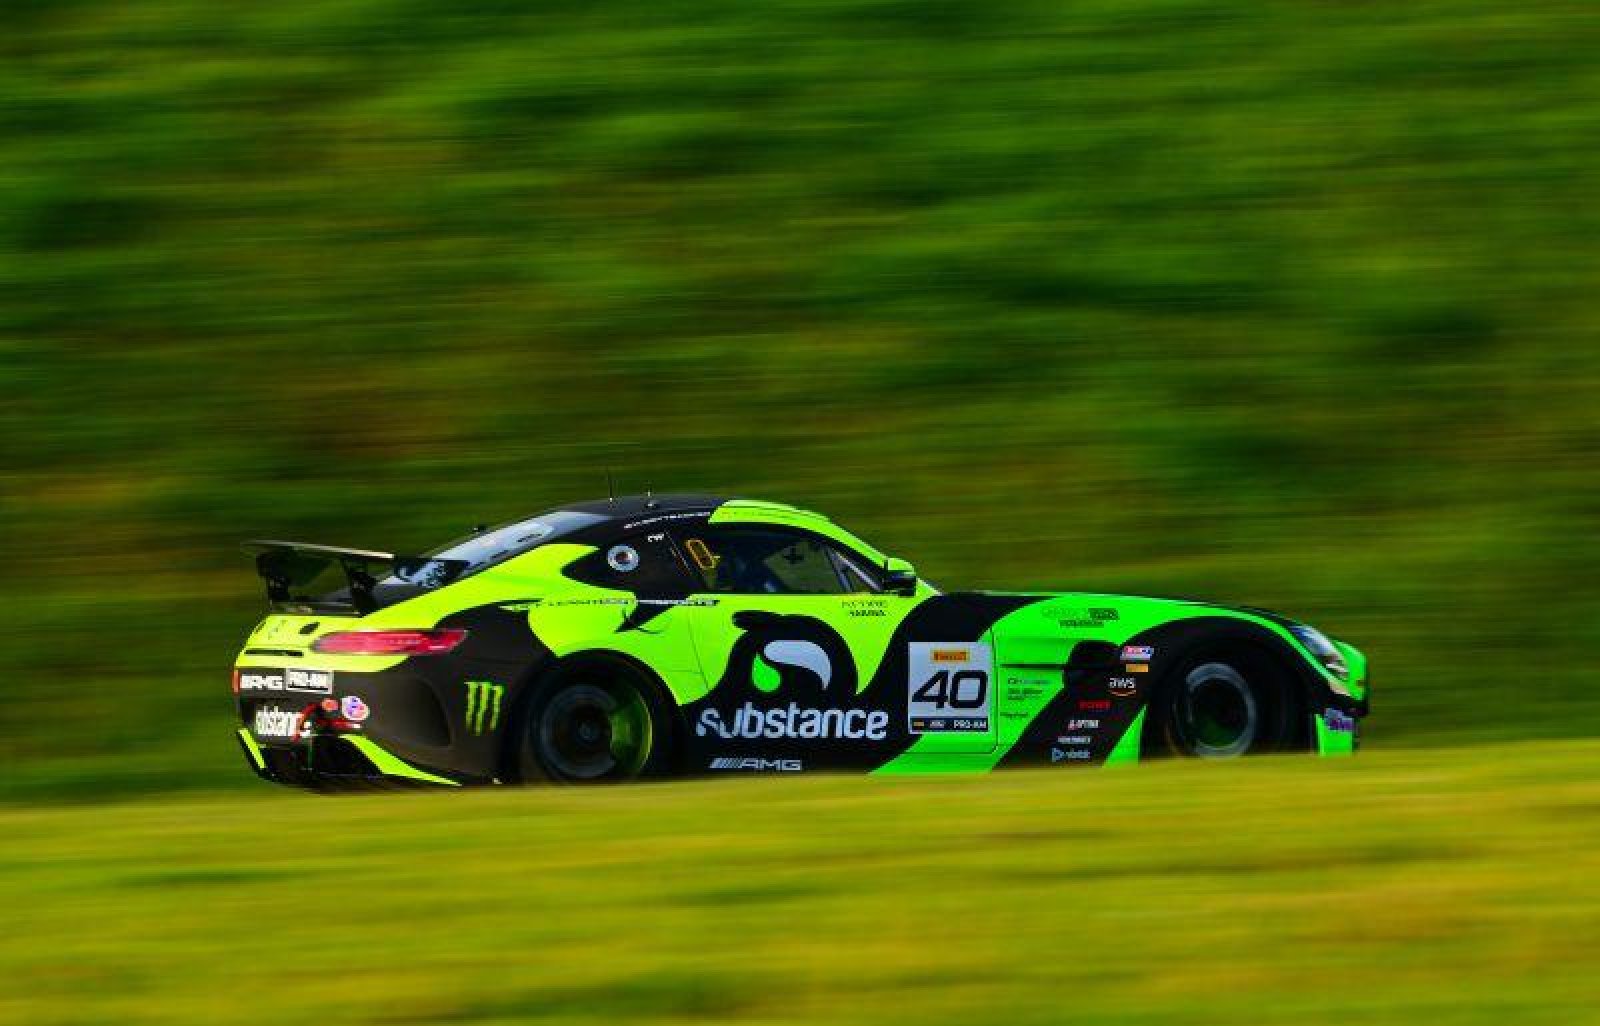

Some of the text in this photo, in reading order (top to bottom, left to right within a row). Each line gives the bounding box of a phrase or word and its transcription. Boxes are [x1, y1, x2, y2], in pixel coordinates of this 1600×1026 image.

[911, 670, 988, 709] 40
[696, 701, 889, 740] substance
[739, 758, 801, 771] AMG
